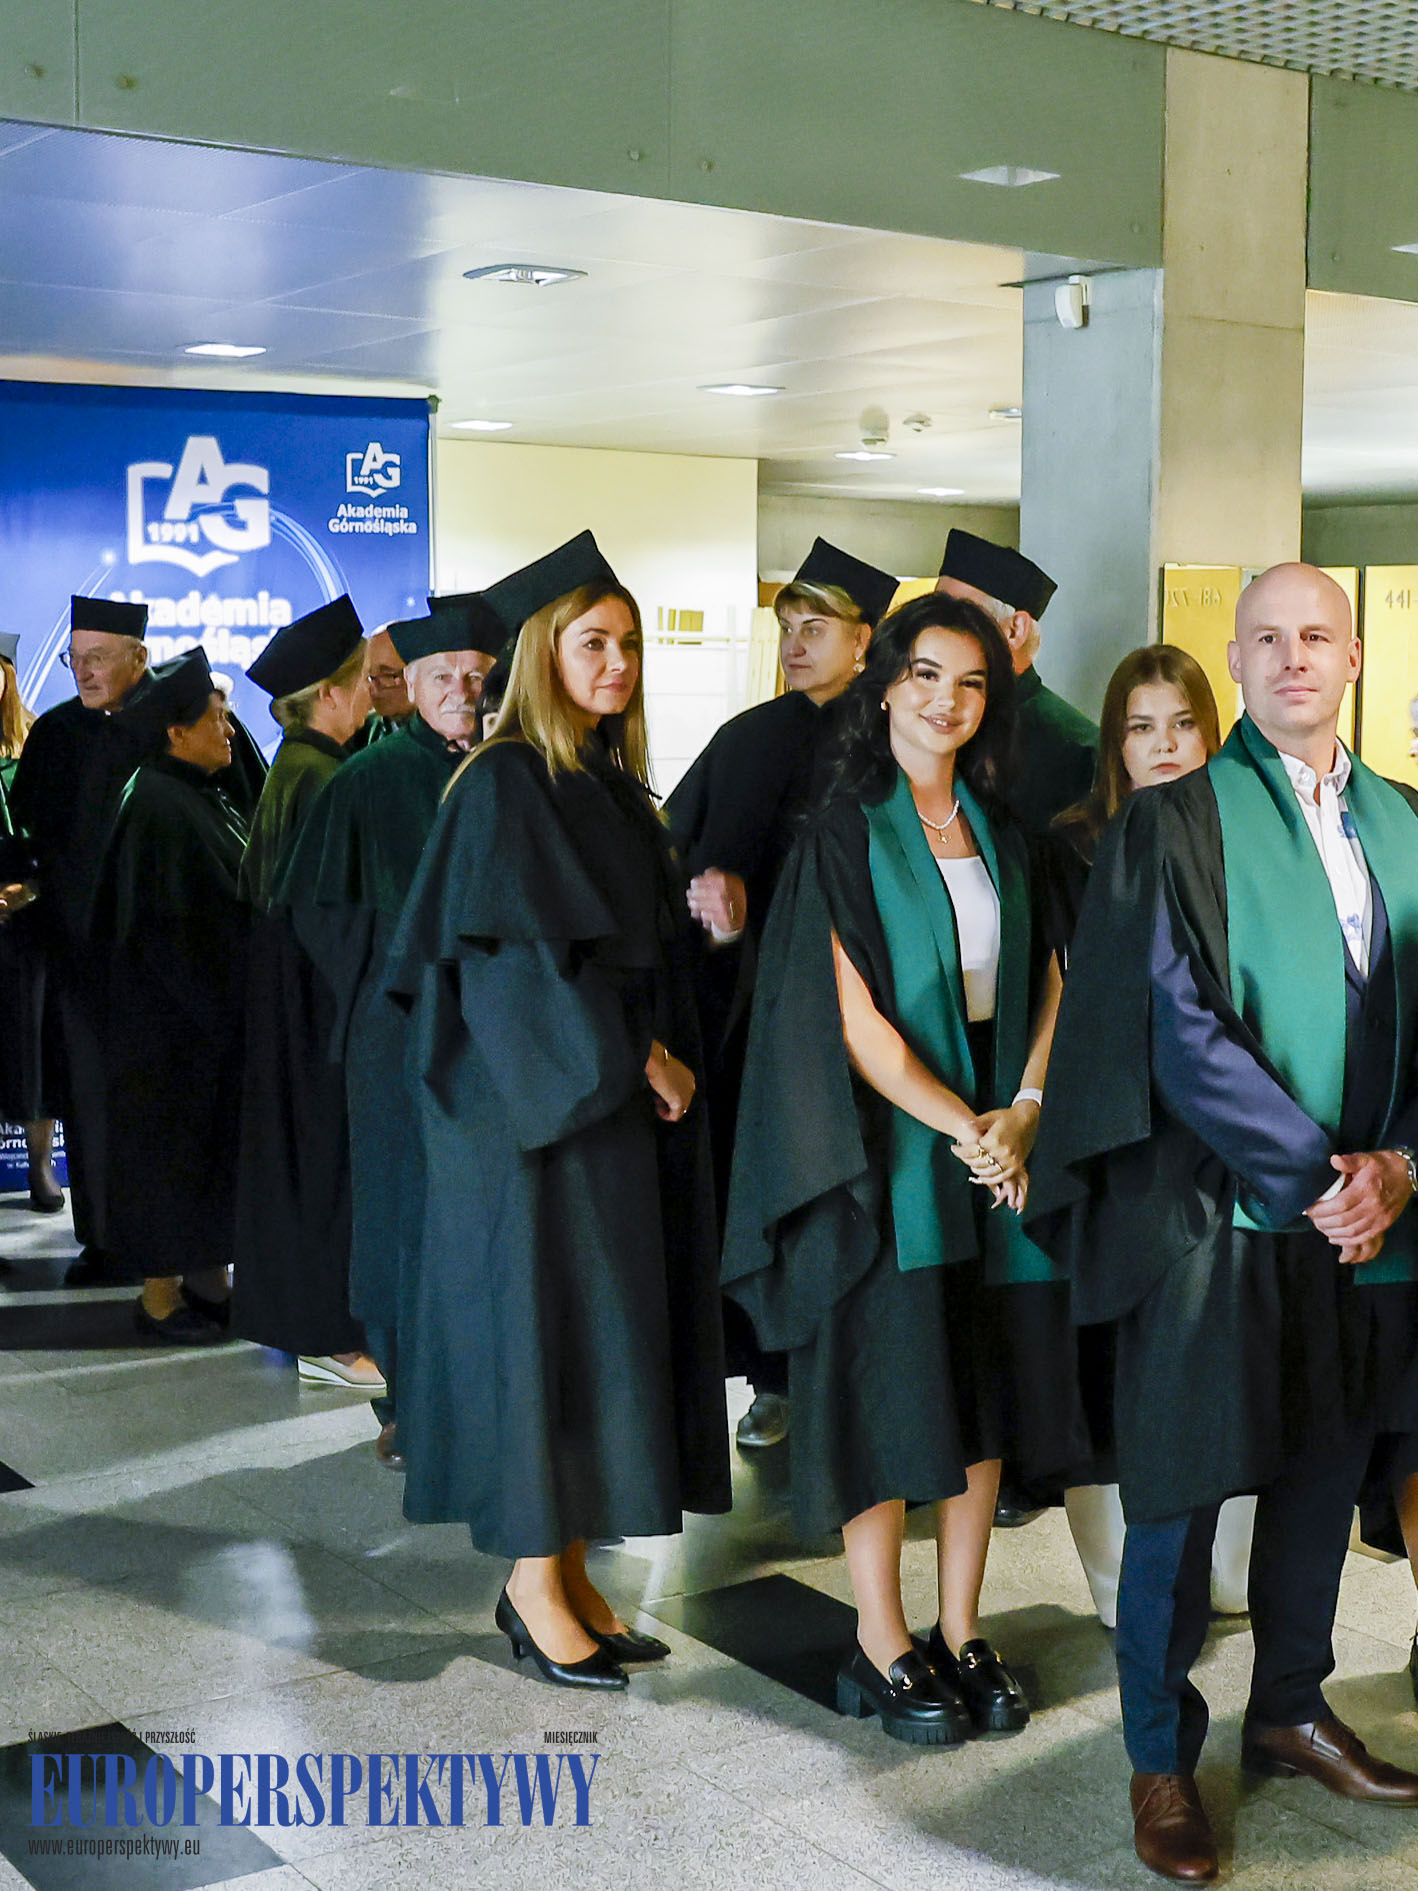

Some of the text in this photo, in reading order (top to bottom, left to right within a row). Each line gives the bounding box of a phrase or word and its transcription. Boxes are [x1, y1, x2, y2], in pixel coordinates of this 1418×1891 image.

[337, 504, 409, 518] Akademia
[147, 522, 199, 543] 1991
[328, 518, 417, 536] Górnośląska
